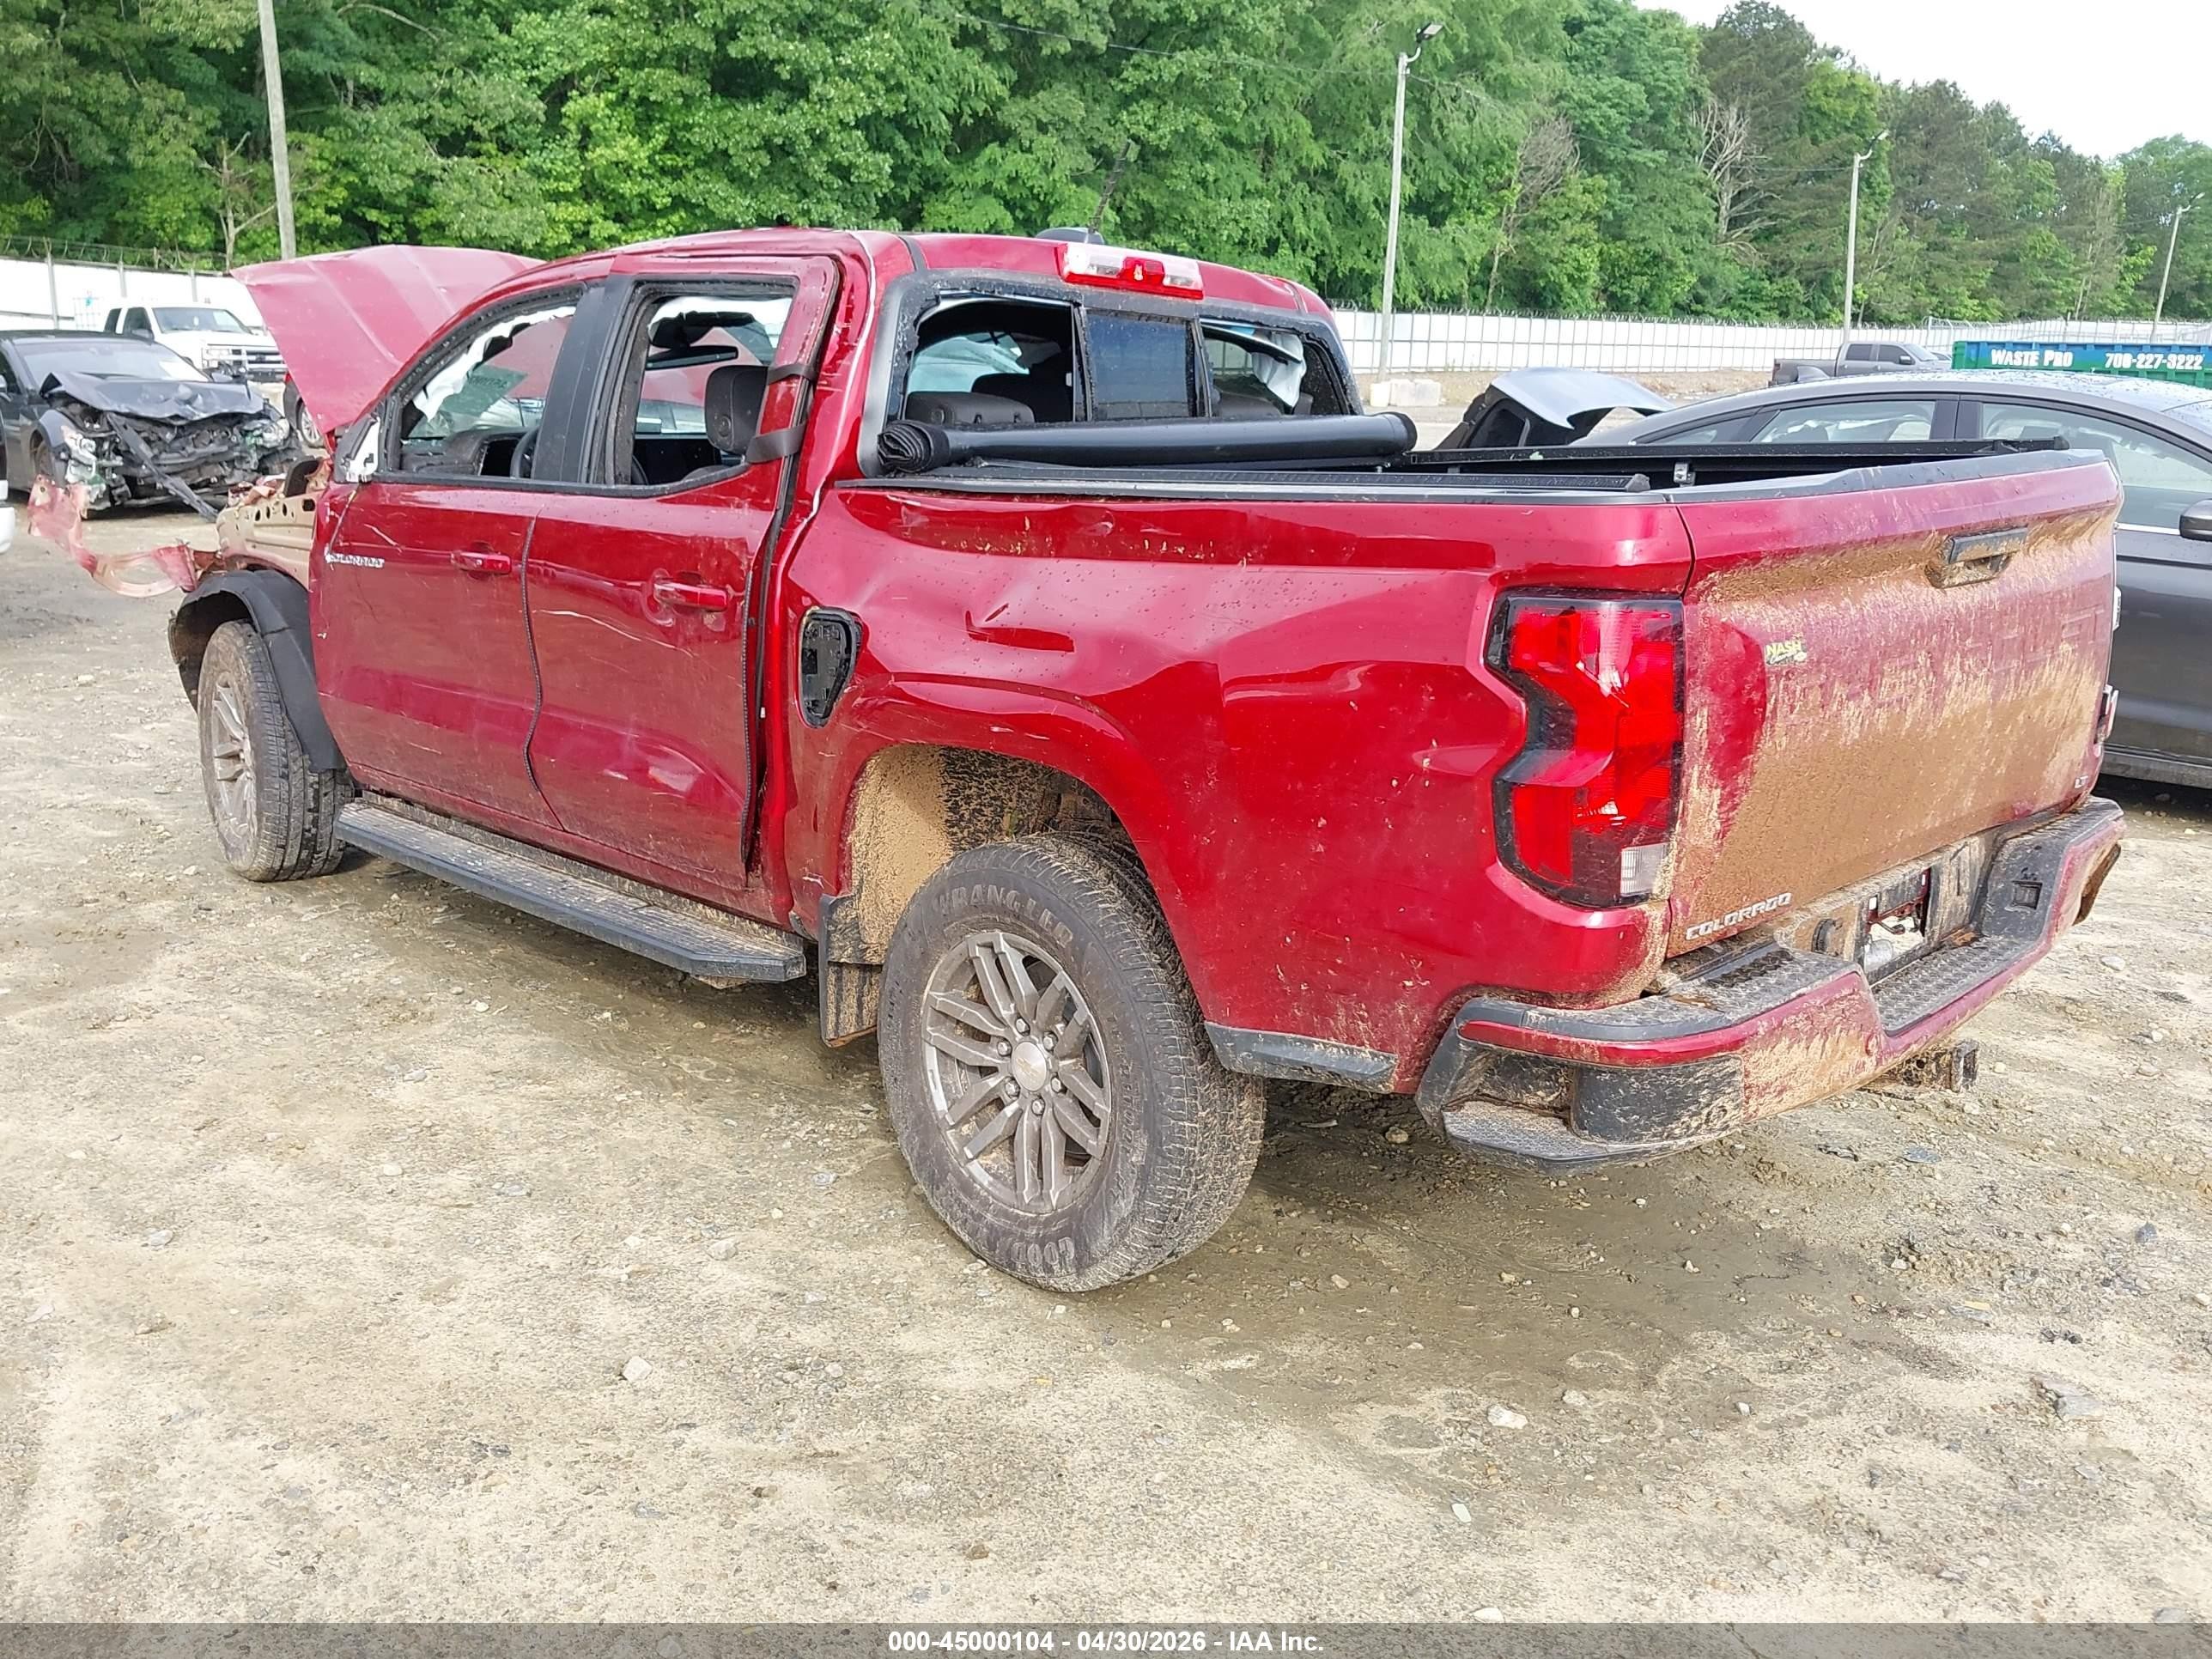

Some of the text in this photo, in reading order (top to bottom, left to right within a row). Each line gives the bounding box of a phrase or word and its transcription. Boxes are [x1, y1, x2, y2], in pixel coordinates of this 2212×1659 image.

[1990, 349, 2073, 368] WASTE PRO
[932, 883, 1074, 949] WRANGLER
[1685, 891, 1794, 941] COLORADO
